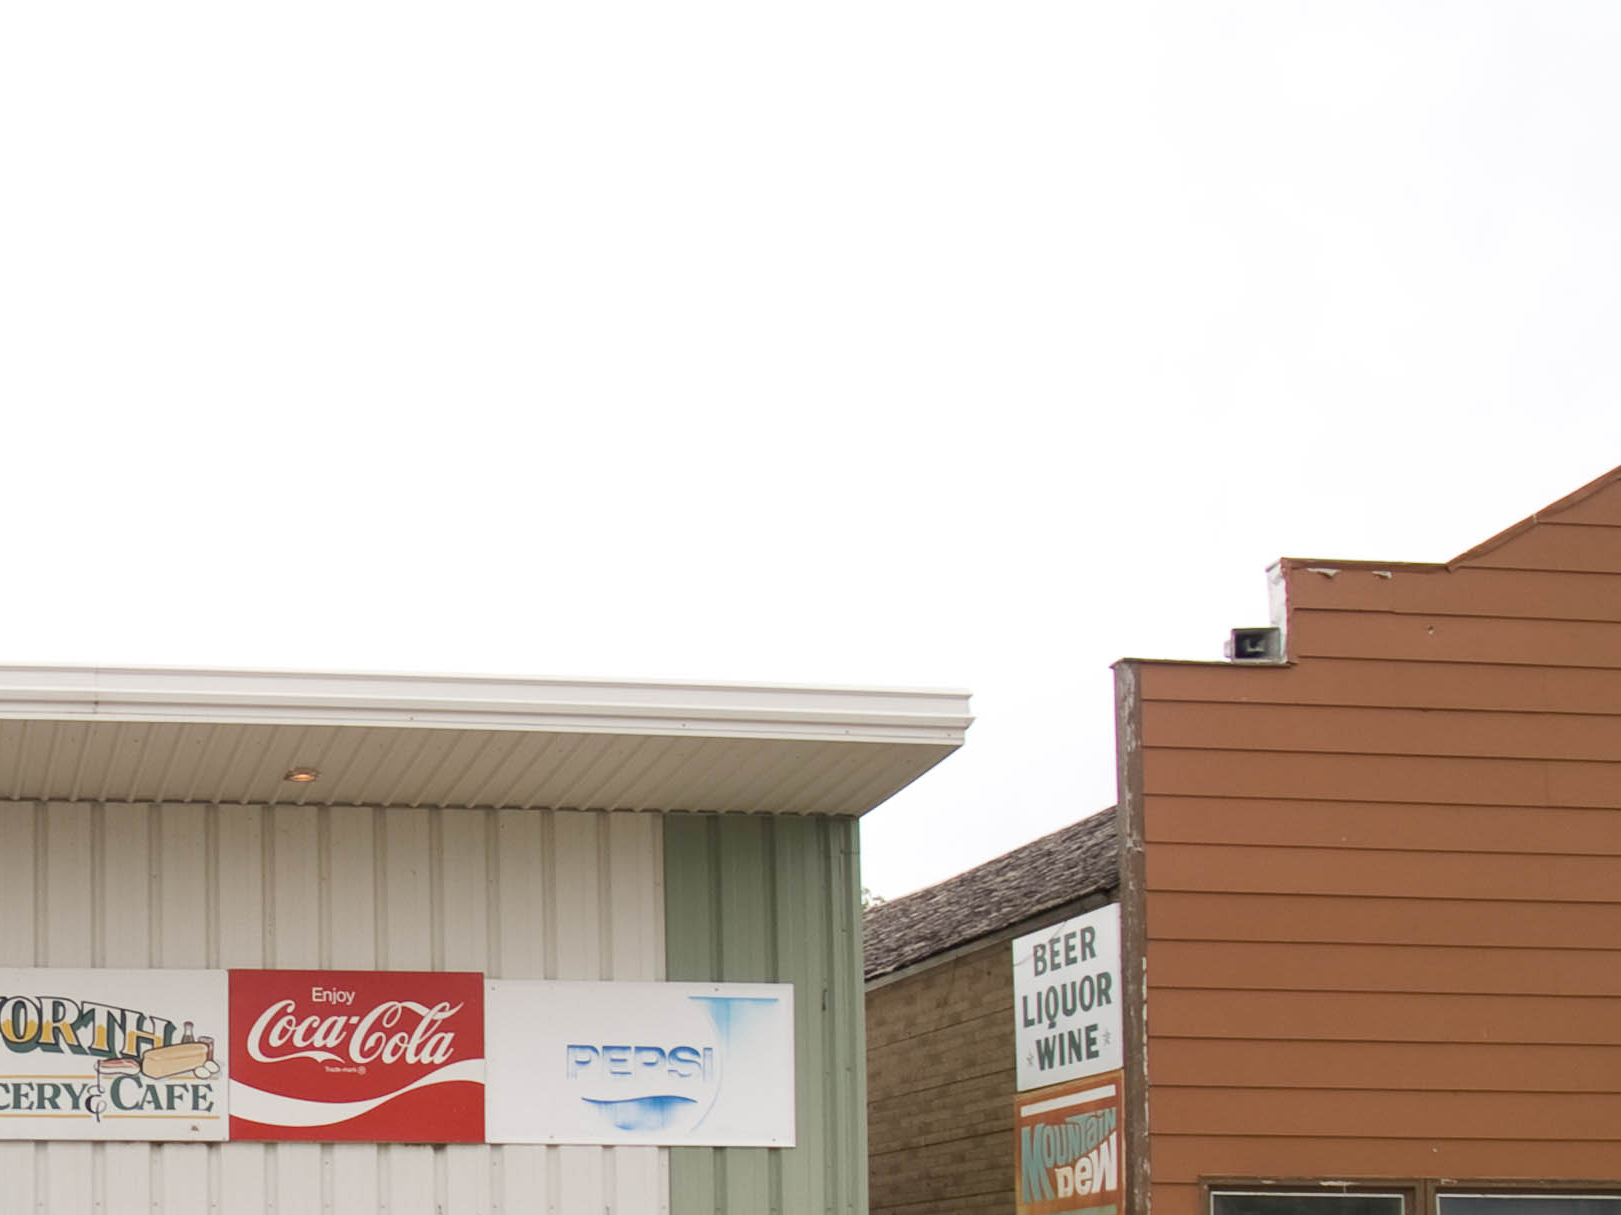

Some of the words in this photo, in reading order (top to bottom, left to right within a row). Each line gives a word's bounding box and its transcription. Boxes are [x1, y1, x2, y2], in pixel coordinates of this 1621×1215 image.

[1033, 925, 1097, 977] BEER
[312, 986, 356, 1006] Enjoy
[1022, 971, 1113, 1029] LIQUOR
[246, 1000, 464, 1065] Coca-Cola
[1036, 1024, 1100, 1071] WINE
[566, 1044, 713, 1081] PEPSI
[110, 1075, 214, 1112] CAFE
